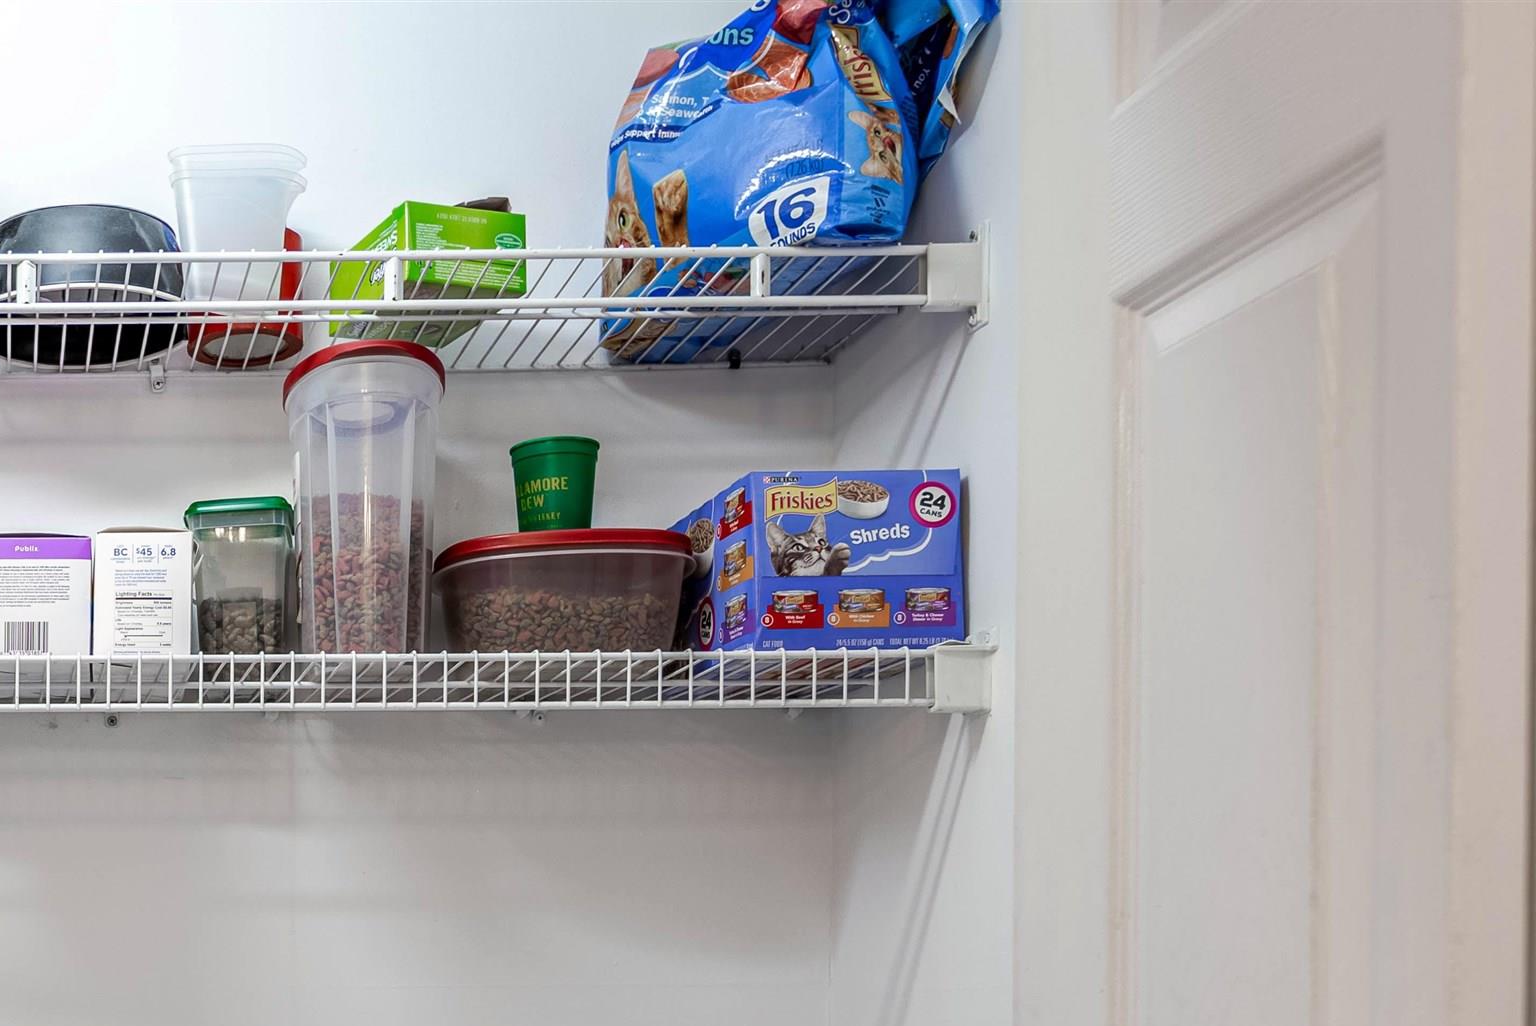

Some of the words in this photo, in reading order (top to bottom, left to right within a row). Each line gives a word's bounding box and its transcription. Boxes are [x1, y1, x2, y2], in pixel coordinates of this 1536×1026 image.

[757, 187, 816, 240] 16
[771, 492, 833, 511] Friskies
[919, 491, 947, 510] 24
[919, 508, 943, 518] CANS
[850, 523, 911, 545] Shreds
[113, 548, 128, 556] BC
[136, 547, 153, 556] $45
[160, 547, 177, 556] 6.8
[702, 610, 711, 629] 24
